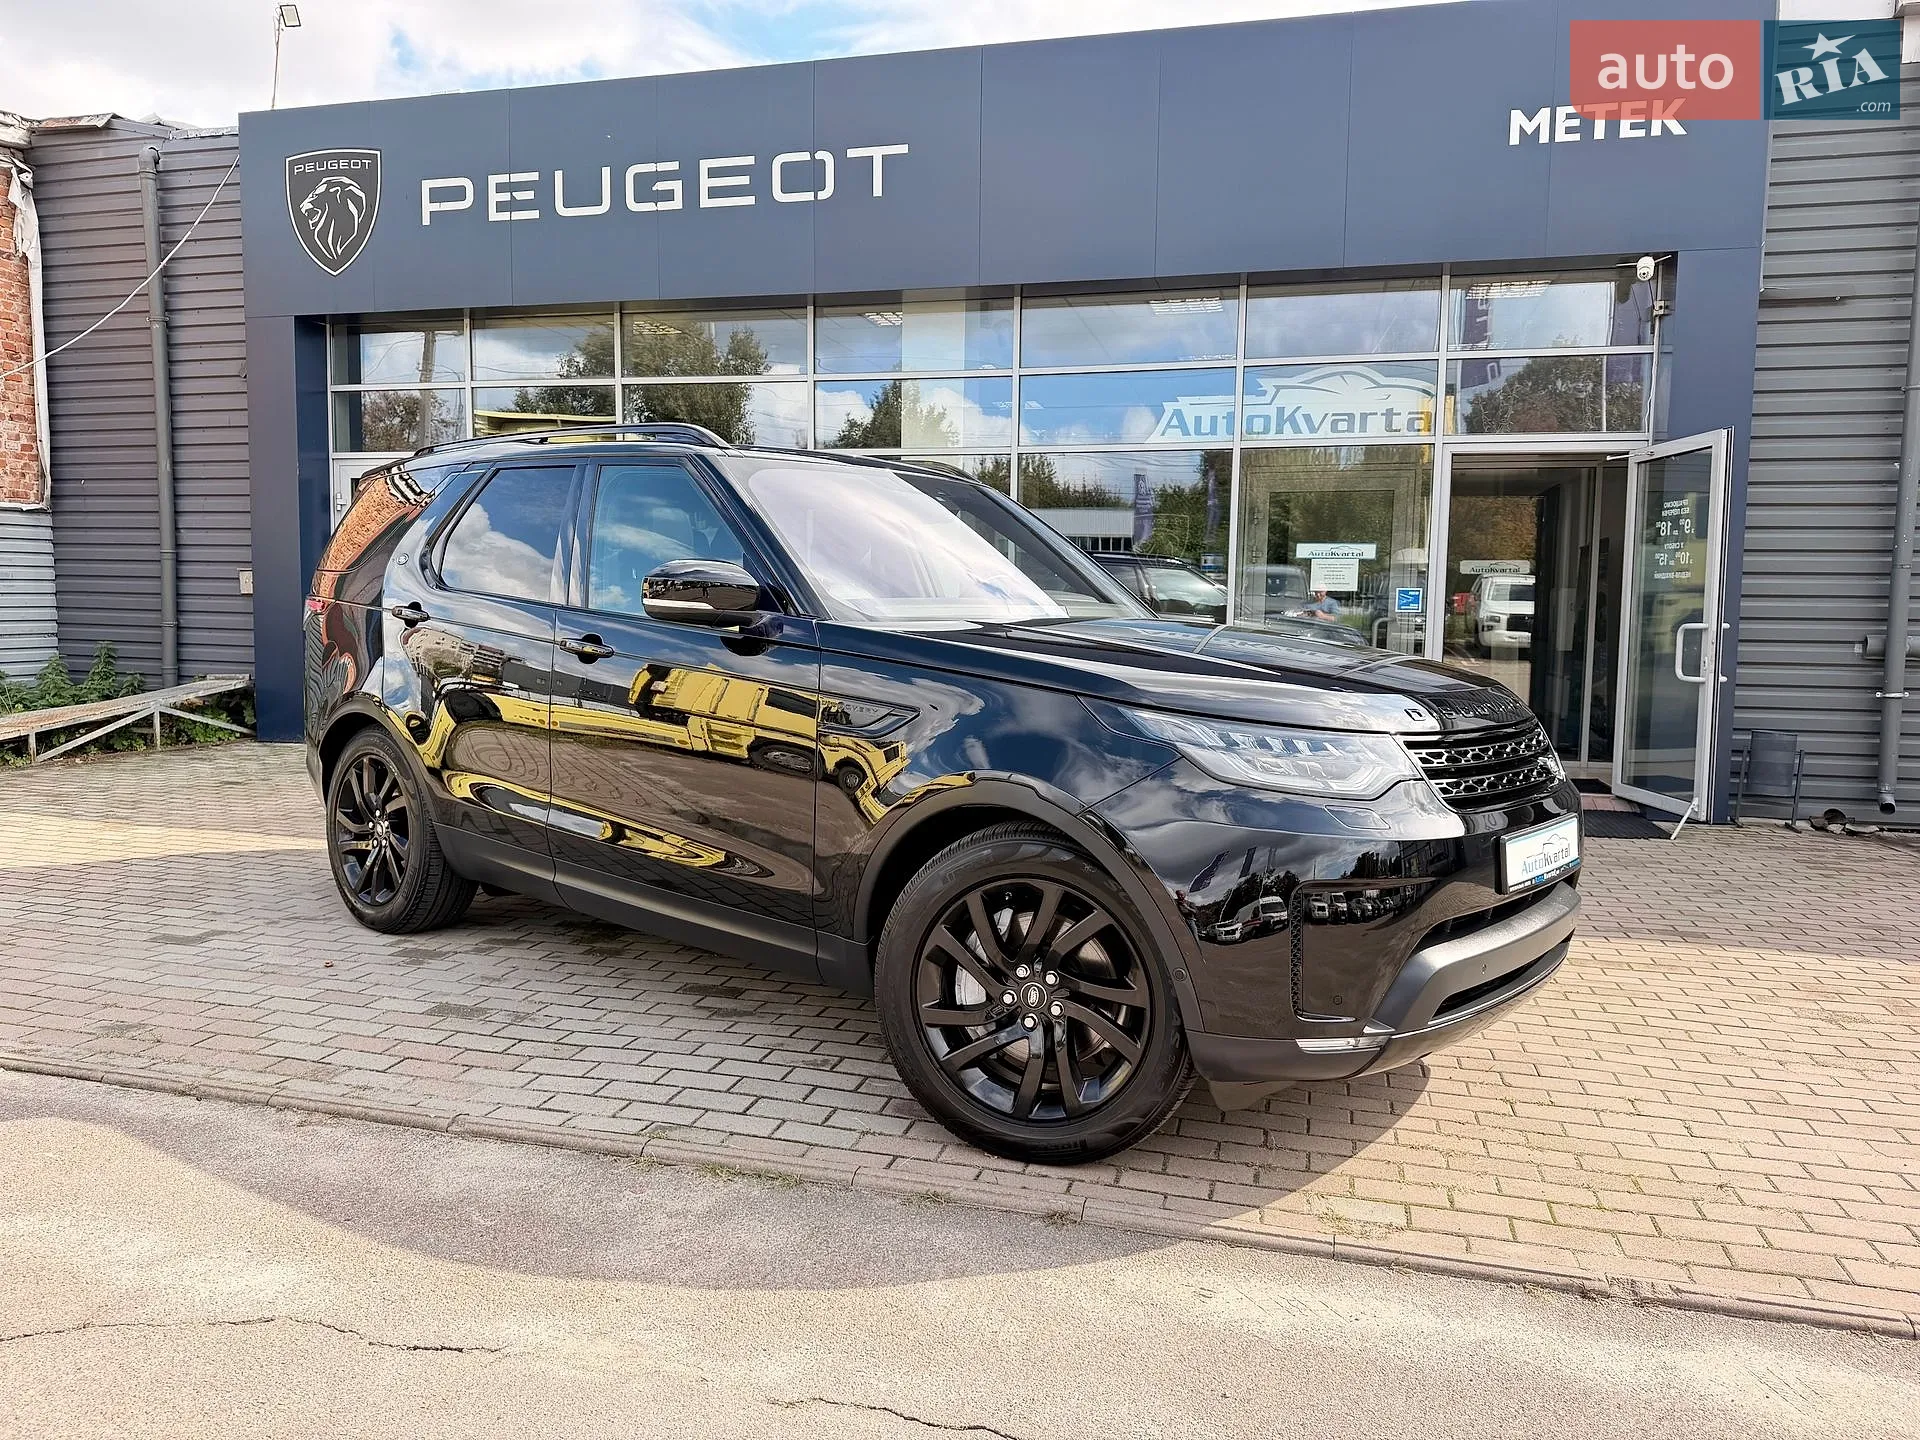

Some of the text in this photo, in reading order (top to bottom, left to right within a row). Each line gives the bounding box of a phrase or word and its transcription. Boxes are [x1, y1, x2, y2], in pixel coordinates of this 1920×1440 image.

[1508, 97, 1688, 146] METEK
[294, 159, 372, 176] PEUGEOT
[420, 143, 909, 226] PEUGEOT
[1160, 405, 1434, 437] AutoKvarta
[1521, 843, 1571, 876] AutoKvartal
